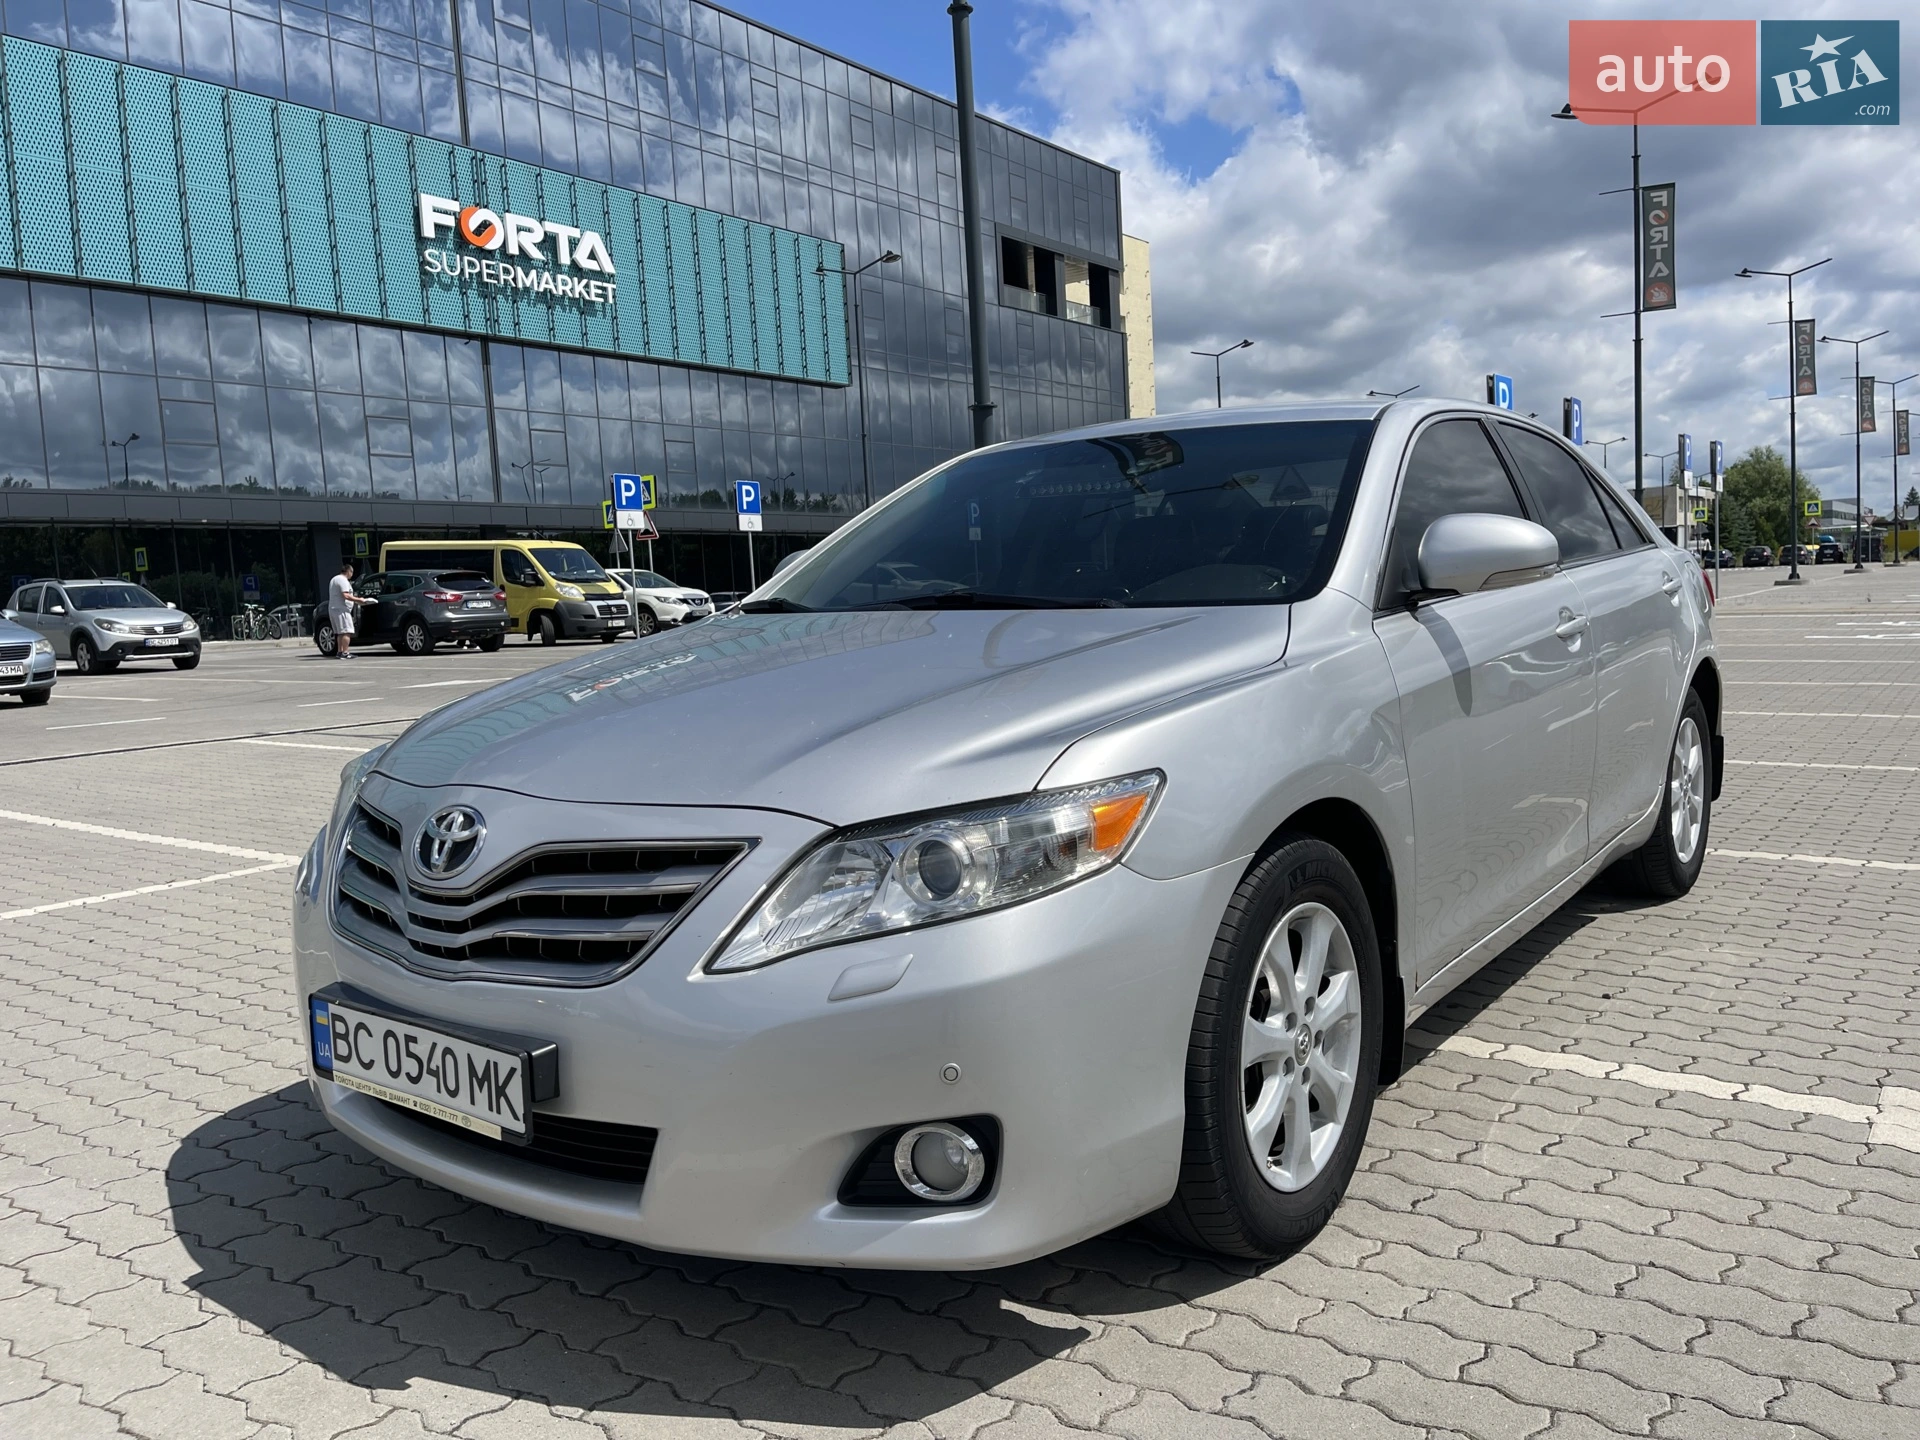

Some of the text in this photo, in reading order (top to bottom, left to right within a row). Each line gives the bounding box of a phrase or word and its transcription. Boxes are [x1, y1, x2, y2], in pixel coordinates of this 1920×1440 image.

[418, 193, 616, 275] FORTA
[424, 249, 617, 304] SUPERMARKET
[1573, 403, 1580, 439] P
[620, 478, 636, 506] P
[741, 485, 755, 510] P
[318, 1041, 331, 1059] UA
[331, 1012, 520, 1122] BC 0540 MK
